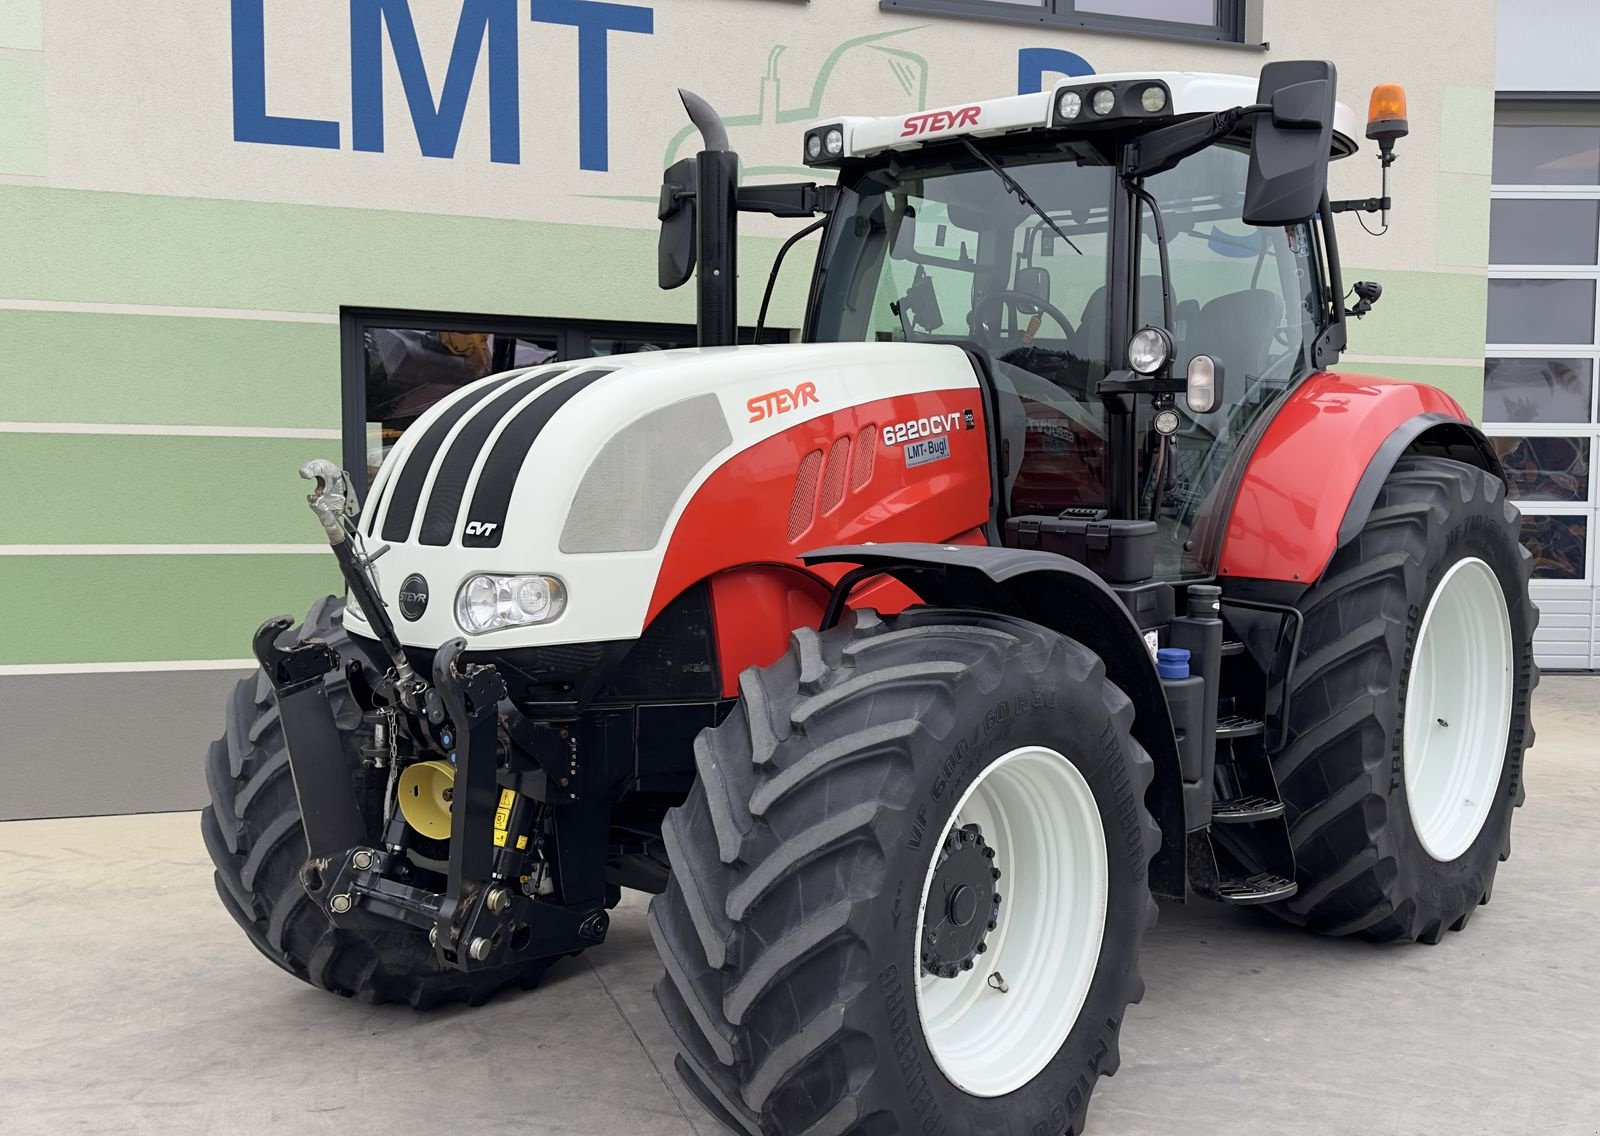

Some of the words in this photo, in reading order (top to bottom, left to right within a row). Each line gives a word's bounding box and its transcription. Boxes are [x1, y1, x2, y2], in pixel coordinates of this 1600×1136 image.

[231, 0, 653, 172] LMT
[900, 105, 981, 138] STEYR
[746, 381, 820, 424] STEYR
[882, 412, 961, 447] 6220CVT
[465, 521, 498, 537] CVT
[399, 591, 427, 604] STEYR
[1100, 716, 1147, 885] TRELLEBORG
[878, 961, 947, 1136] RELLEBORG
